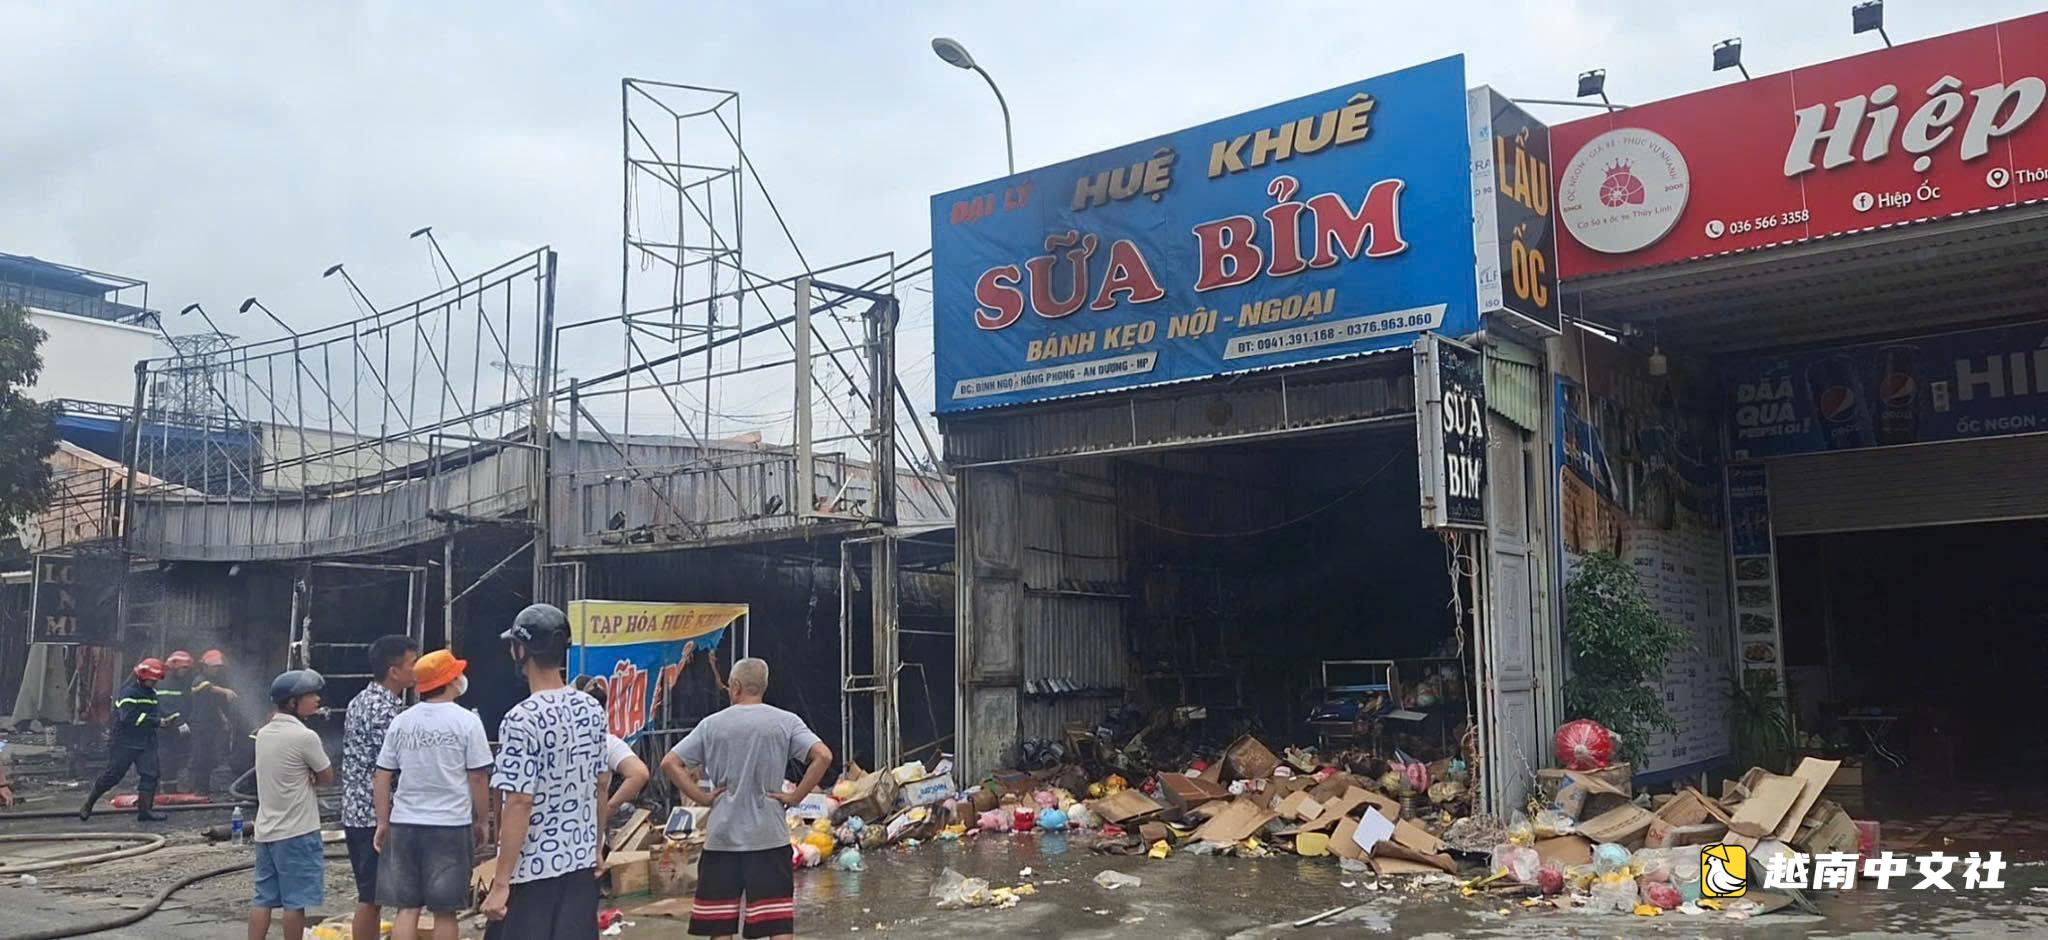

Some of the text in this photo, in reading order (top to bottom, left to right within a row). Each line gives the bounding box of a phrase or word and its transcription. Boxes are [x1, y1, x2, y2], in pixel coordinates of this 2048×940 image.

[1071, 146, 1178, 211] HUỆ
[1208, 92, 1377, 179] KHUÊ
[1784, 75, 2047, 178] Hiệp
[1496, 126, 1548, 217] LẨU
[1916, 180, 1941, 201] Ốc
[974, 175, 1409, 331] SỮA BỈM
[1729, 209, 1810, 235] 036 566 3358
[1511, 223, 1548, 308] ỐC
[1026, 331, 1096, 362] BÁNH
[1104, 320, 1157, 351] KẸO
[1167, 307, 1218, 340] NỘI
[1238, 288, 1337, 328] NGOẠI
[1443, 384, 1483, 438] SỮA
[1983, 415, 2037, 432] NGON
[1448, 440, 1479, 500] BỈM
[590, 614, 623, 639] TẠP
[625, 610, 659, 633] HÓA
[661, 610, 695, 631] HUÊ
[590, 658, 648, 739] ỮA
